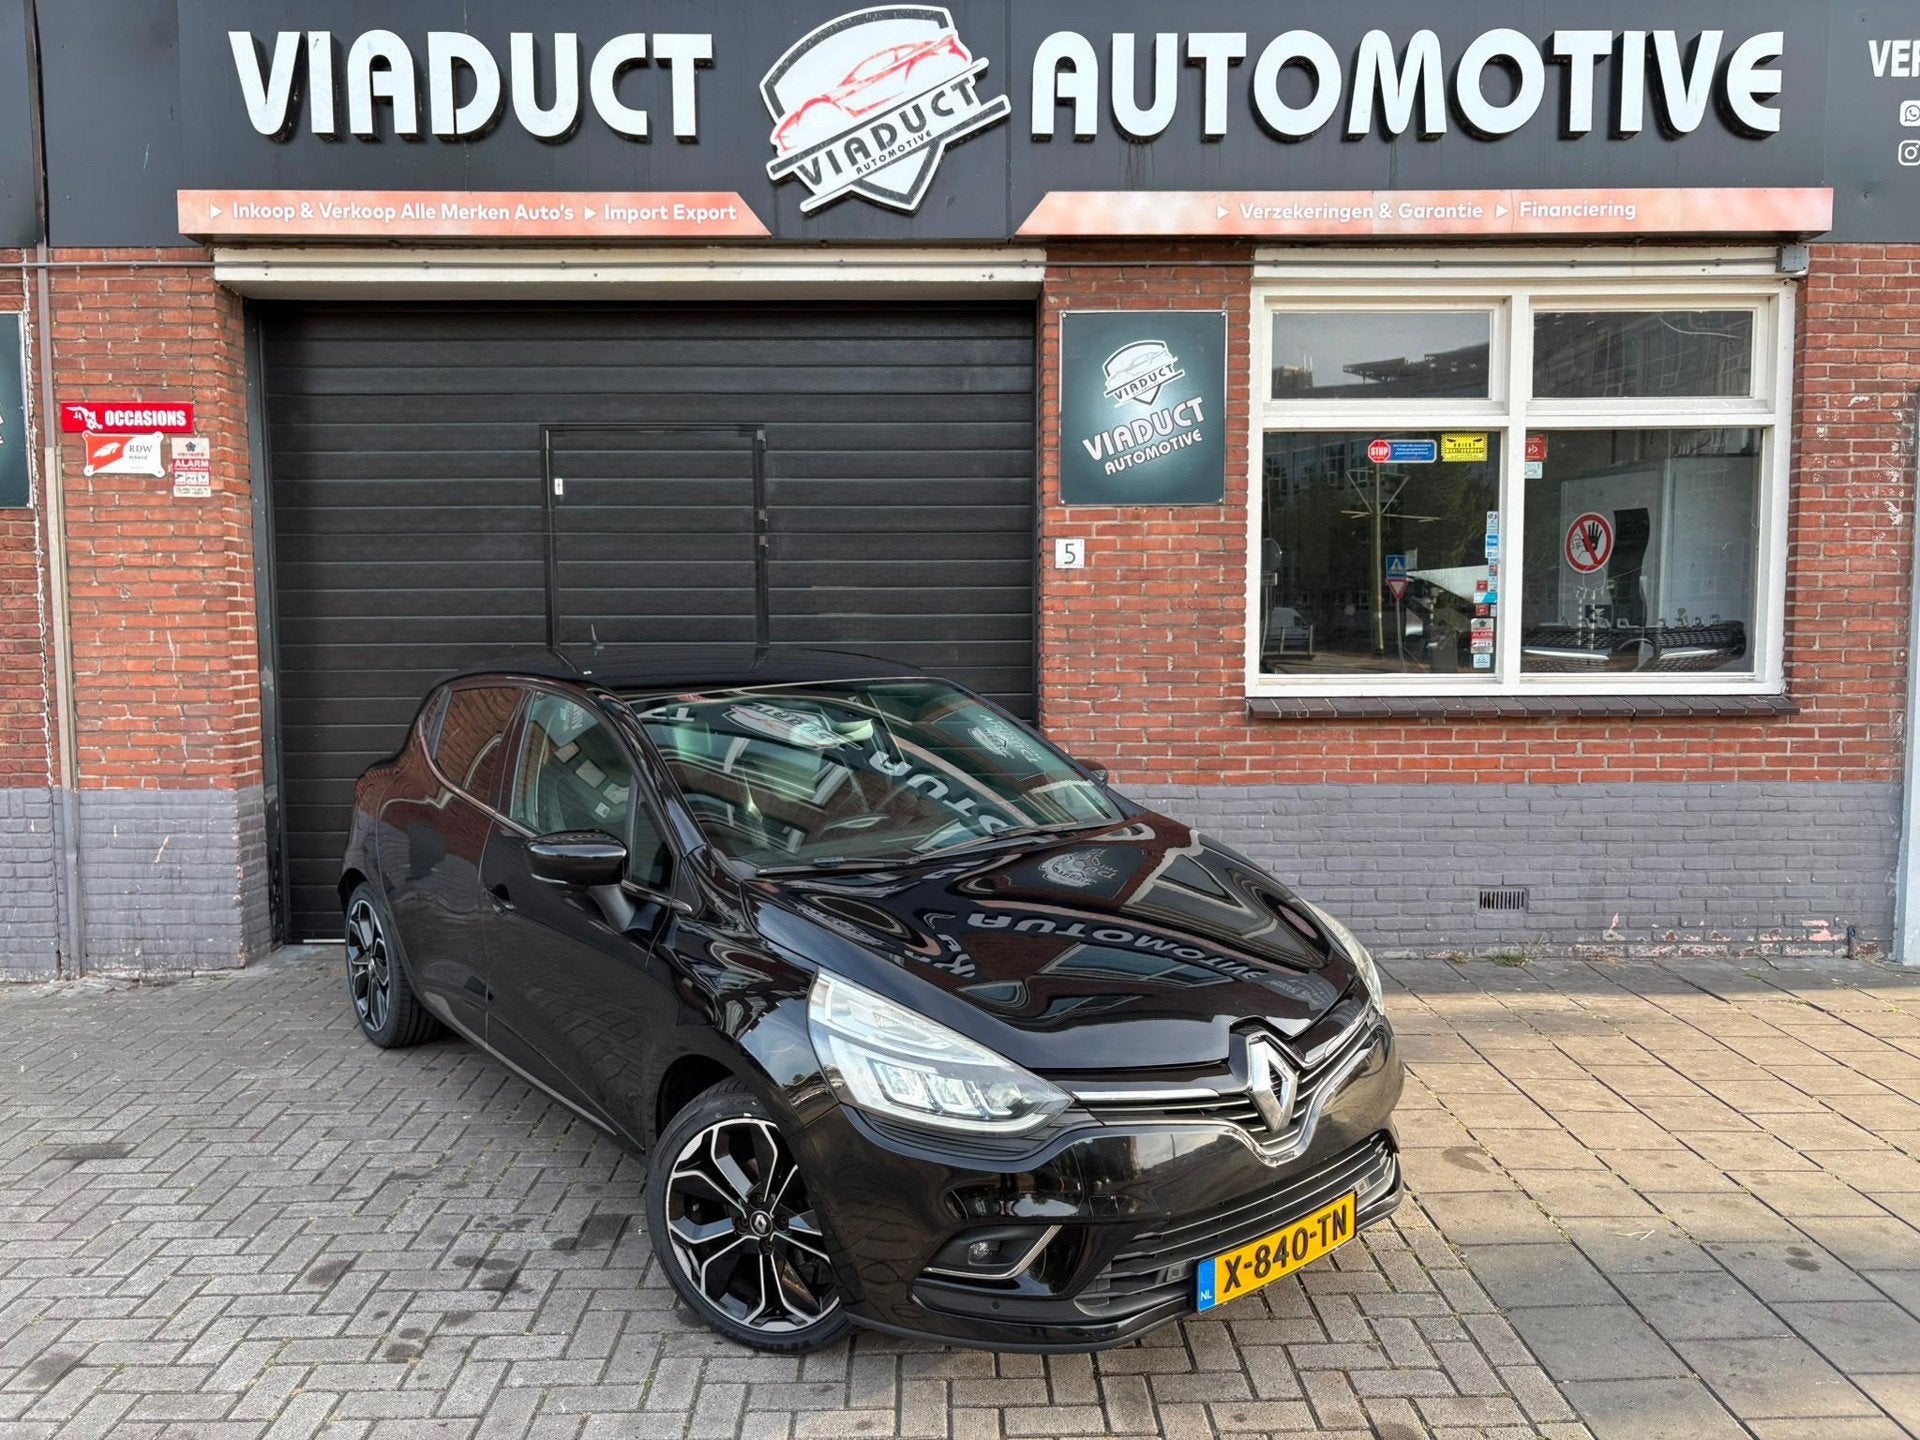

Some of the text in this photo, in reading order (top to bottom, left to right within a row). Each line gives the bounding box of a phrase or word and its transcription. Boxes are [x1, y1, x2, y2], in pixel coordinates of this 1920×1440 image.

[228, 28, 713, 137] VIADUCT
[1031, 28, 1785, 137] AUTOMOTIVE
[797, 76, 977, 187] VIADUCT
[855, 129, 933, 175] AUTOMOTIVE
[233, 202, 575, 222] Inkoop & Verkoop Alle Merken Auto's
[604, 203, 738, 224] Import Export
[1239, 201, 1483, 222] Verzekeringen & Garantie
[1519, 200, 1637, 221] Financiering
[1114, 363, 1173, 400] VIADUCT
[104, 410, 187, 426] OCCASIONS
[1082, 396, 1205, 461] VIADUCT
[129, 444, 152, 453] RDW
[1104, 428, 1203, 476] AUTOMOTIVE
[1370, 446, 1389, 456] STOP
[175, 459, 209, 468] ALARM
[1063, 543, 1076, 565] 5
[1223, 1203, 1347, 1294] X-840-TN
[1200, 1290, 1213, 1301] NL
